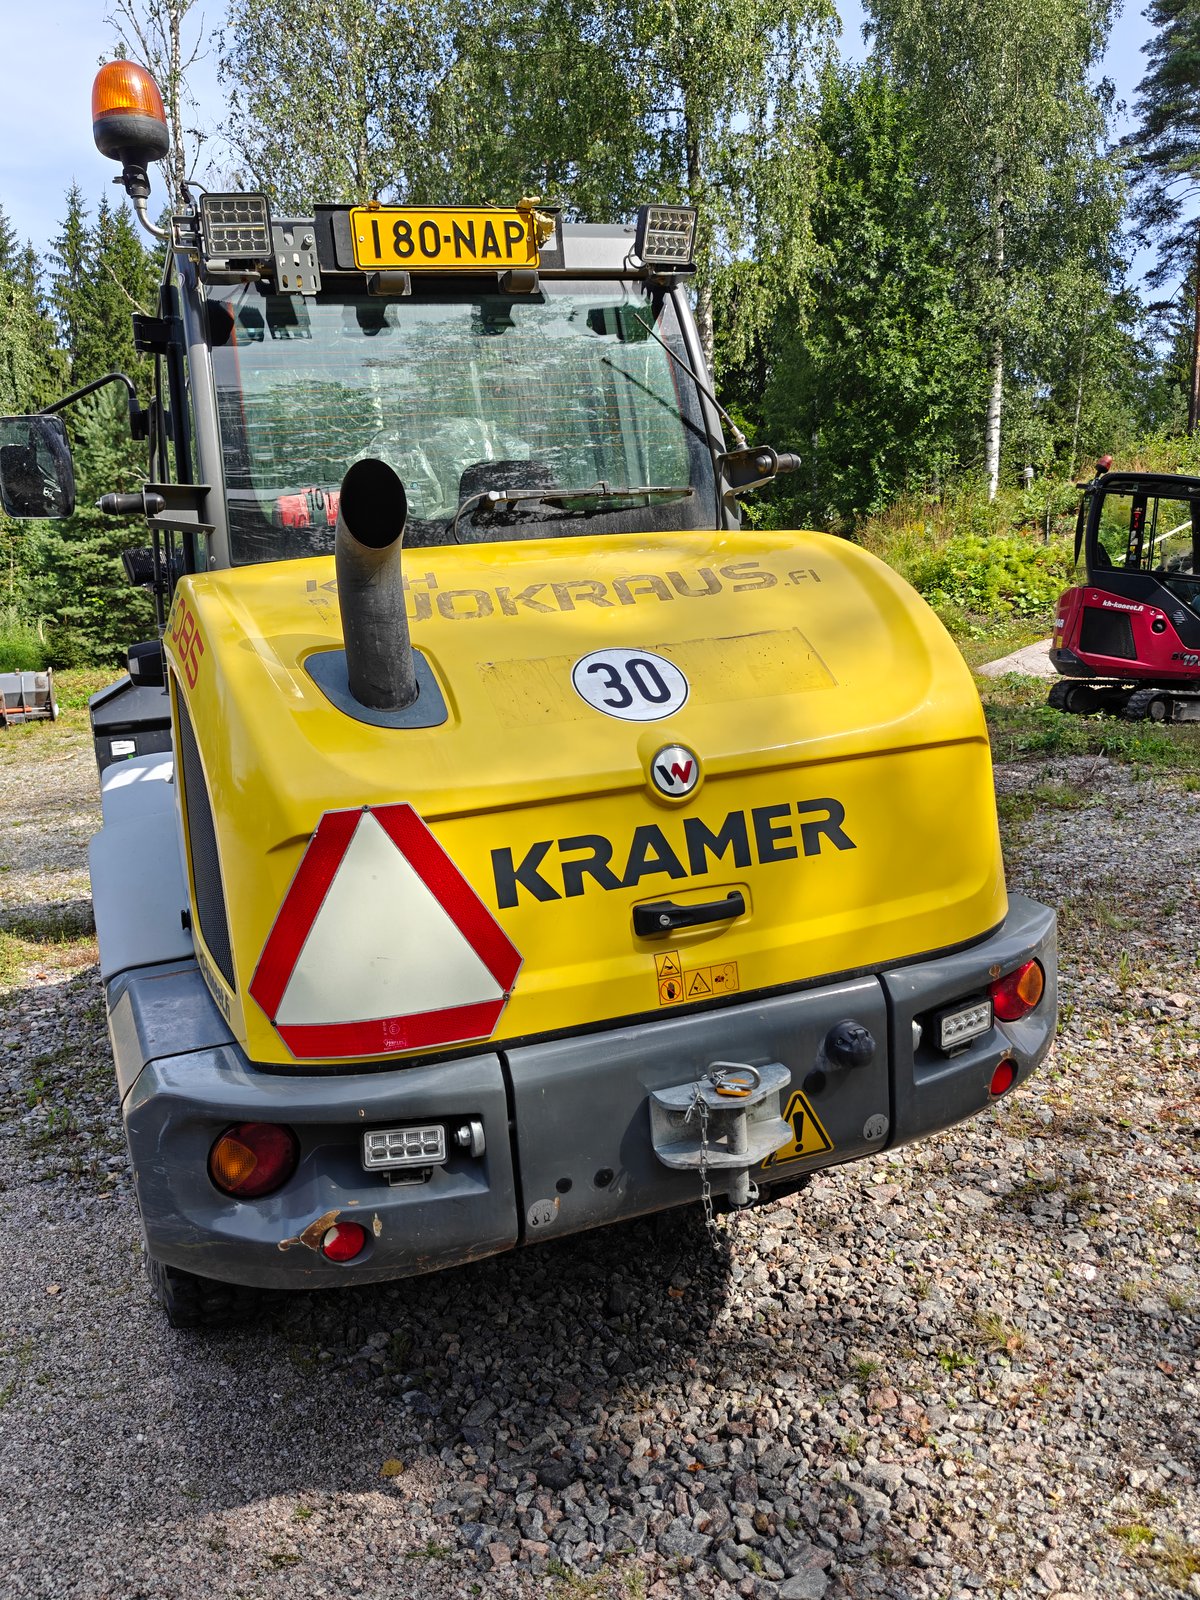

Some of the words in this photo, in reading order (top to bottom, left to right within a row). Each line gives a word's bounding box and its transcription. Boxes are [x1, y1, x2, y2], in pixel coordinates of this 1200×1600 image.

[371, 219, 526, 260] 180-NAP
[586, 657, 672, 709] 30
[490, 797, 857, 910] KRAMER
